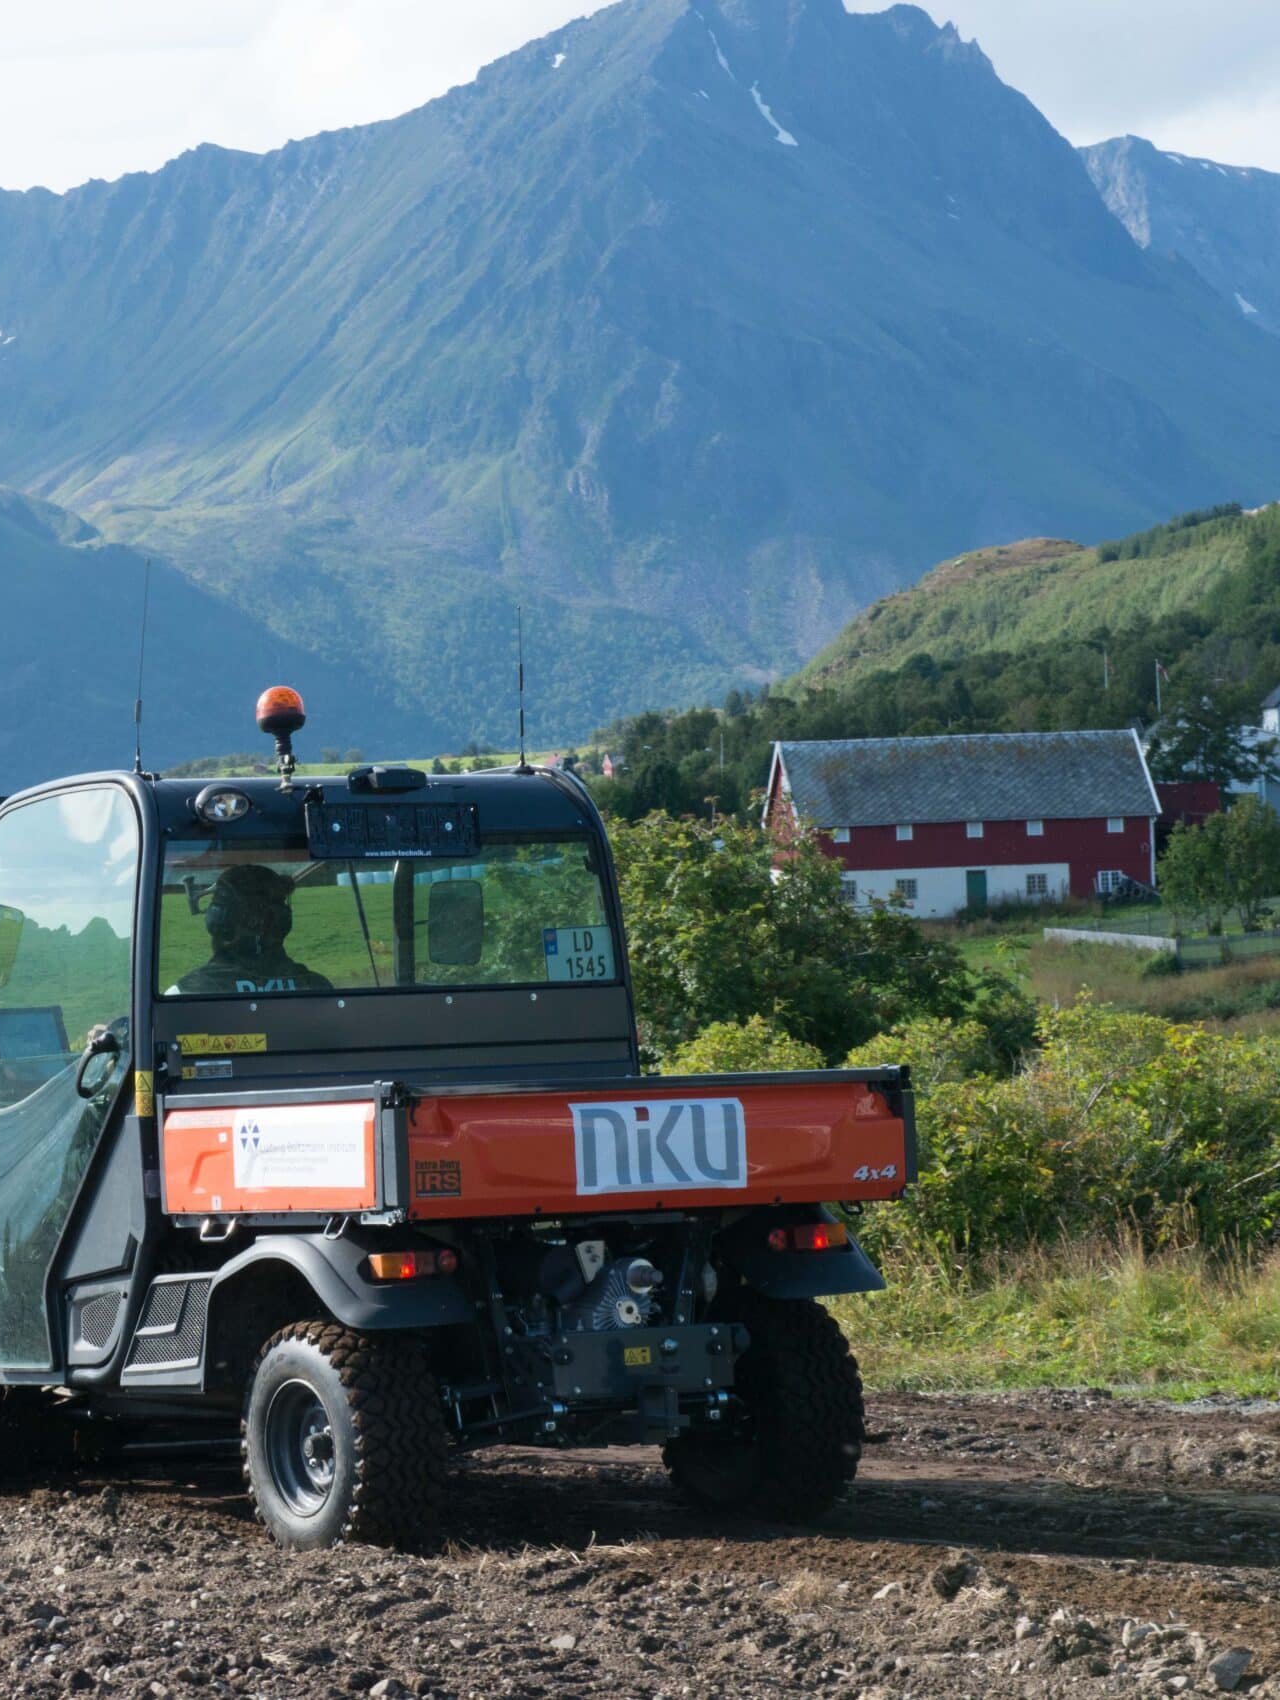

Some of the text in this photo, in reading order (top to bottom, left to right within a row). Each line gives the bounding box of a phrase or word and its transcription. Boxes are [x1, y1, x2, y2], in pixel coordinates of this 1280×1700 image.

[573, 931, 593, 952] LD
[565, 955, 606, 979] 1545
[417, 1173, 459, 1191] IRS
[853, 1164, 897, 1181] 4x4
